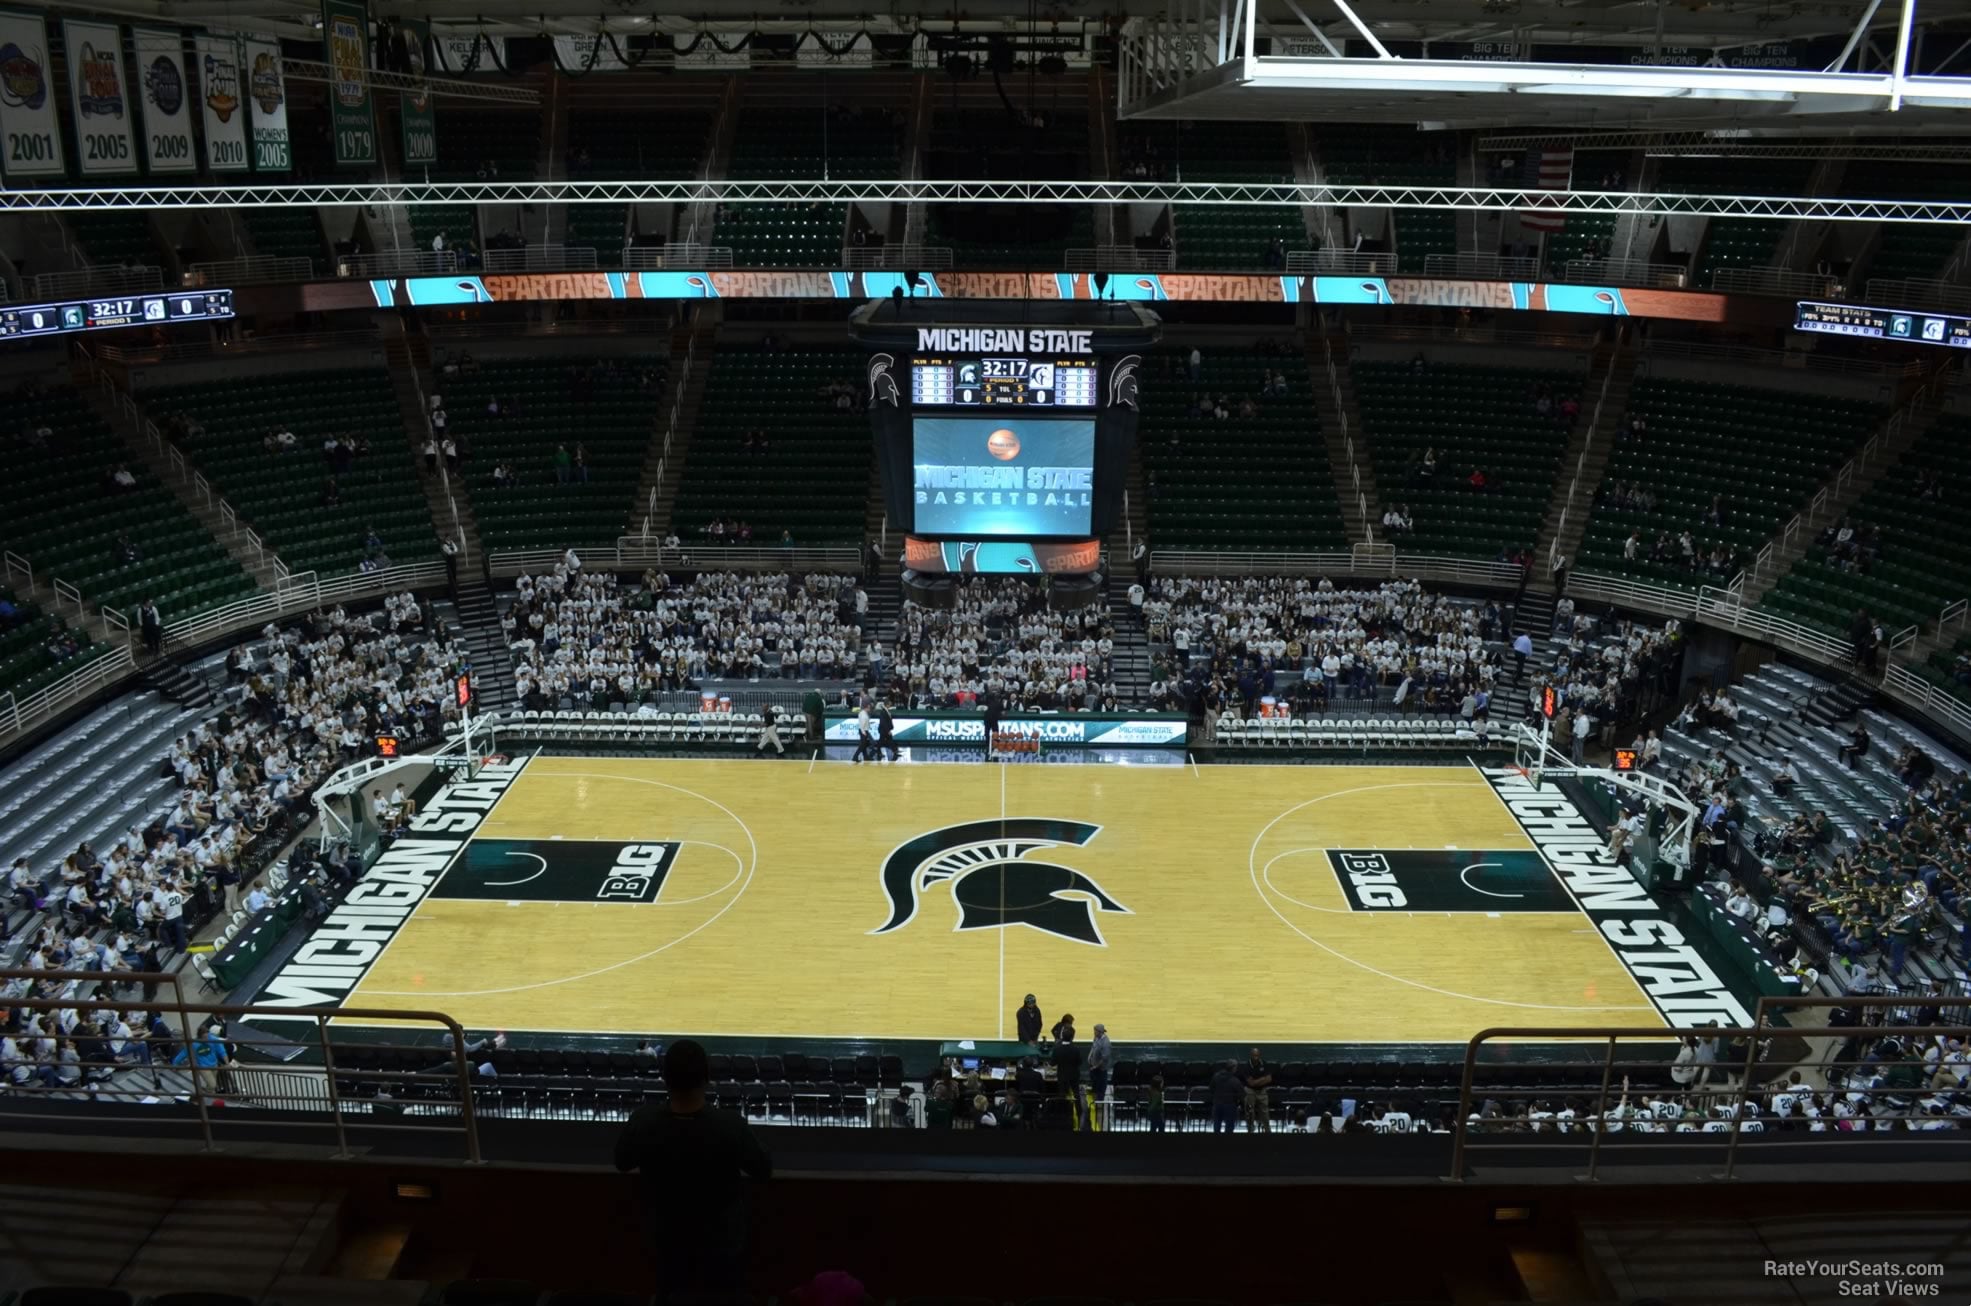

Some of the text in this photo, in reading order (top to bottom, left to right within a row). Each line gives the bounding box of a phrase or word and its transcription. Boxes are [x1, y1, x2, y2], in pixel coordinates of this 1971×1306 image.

[1473, 43, 1493, 53] BIG
[1743, 46, 1787, 55] BIG TEN
[1631, 55, 1697, 65] CHAMPIONS
[1731, 57, 1797, 67] CHAMPIONS
[9, 133, 53, 160] 2001
[86, 134, 128, 159] 2005
[153, 135, 188, 158] 2009
[212, 141, 243, 163] 2010
[340, 131, 371, 158] 1979
[407, 133, 432, 158] 2000
[257, 143, 288, 168] 2005
[484, 273, 609, 301] SPARTANS
[713, 272, 831, 298] SPARTANS
[936, 273, 1059, 299] SPARTANS
[1163, 275, 1283, 301] SPARTANS
[1388, 279, 1512, 308] SPARTANS
[93, 300, 134, 316] 32:17
[180, 299, 192, 314] 0
[1815, 305, 1871, 317] TEAM STATS
[32, 312, 44, 329] 0
[95, 319, 125, 327] PERIOD
[917, 327, 1094, 353] MICHIGAN STATE
[983, 361, 1027, 376] 32:17
[962, 389, 972, 403] 0
[1036, 390, 1046, 403] 0
[914, 465, 1092, 489] MICHIGAN STATE
[915, 491, 1090, 506] BASKETBALL
[926, 721, 1085, 737] MSUSPTANS.COM
[1618, 759, 1630, 768] 35
[237, 756, 530, 1025] MICHIGAN STATE
[1480, 766, 1757, 1029] MICHIGAN STATE
[168, 895, 181, 907] 20
[1659, 1104, 1675, 1115] 20
[1781, 1098, 1793, 1109] 20
[1390, 1118, 1405, 1129] 20
